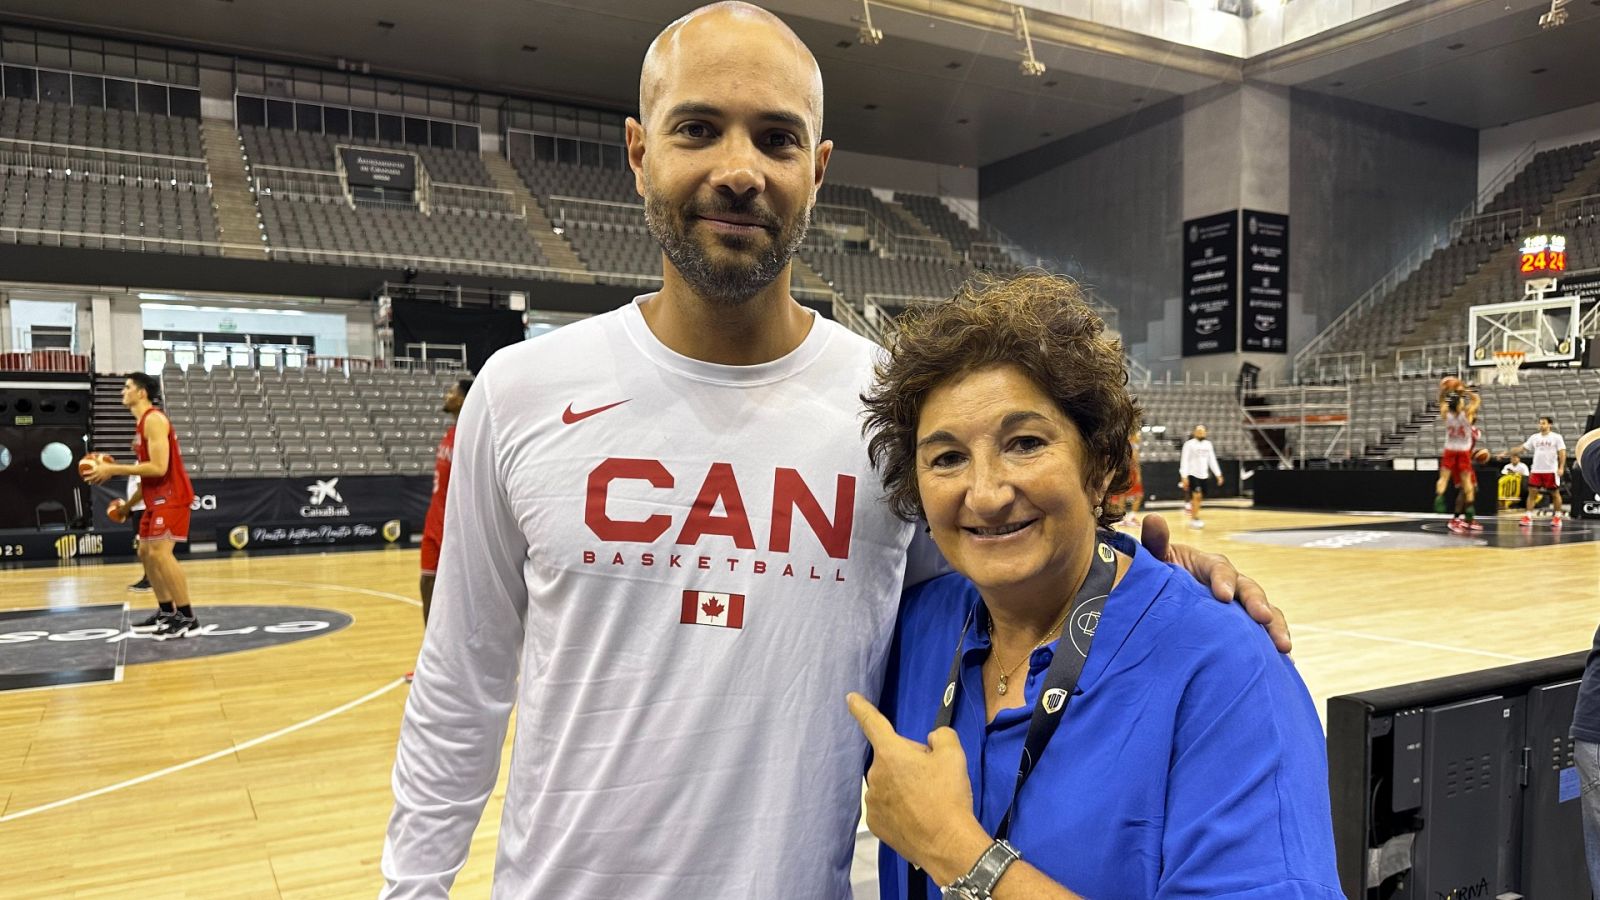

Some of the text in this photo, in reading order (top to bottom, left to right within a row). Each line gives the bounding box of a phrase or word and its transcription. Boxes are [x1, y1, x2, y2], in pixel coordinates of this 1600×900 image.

[1520, 253, 1546, 272] 24
[1549, 252, 1565, 270] 24
[300, 505, 350, 518] CaixaBank
[584, 457, 857, 560] CAN
[55, 533, 103, 558] 100 AÑOS
[583, 550, 846, 582] BASKETBALL
[1047, 693, 1062, 709] 100
